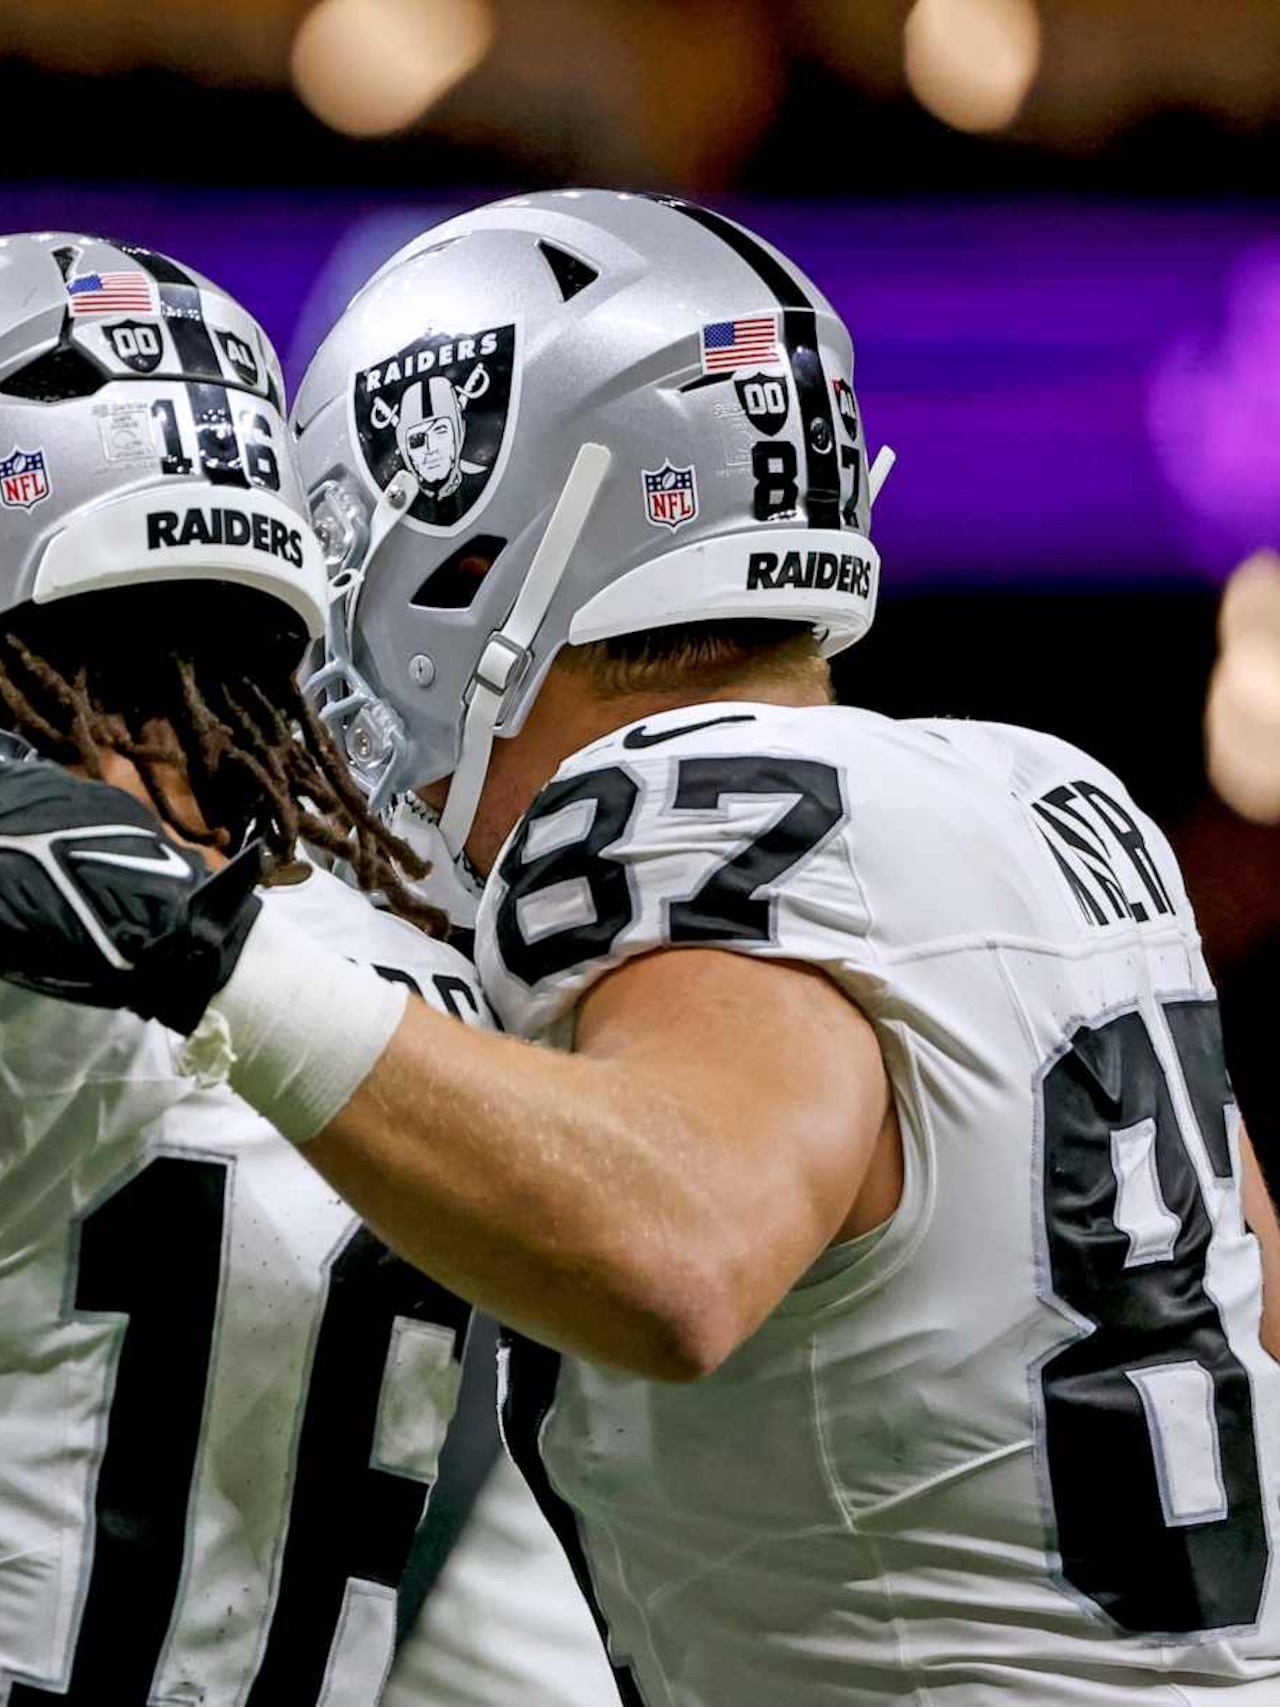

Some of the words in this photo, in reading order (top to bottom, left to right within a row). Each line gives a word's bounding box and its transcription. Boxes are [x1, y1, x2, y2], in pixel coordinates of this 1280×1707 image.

[111, 328, 159, 356] 00
[367, 333, 498, 392] RAIDERS
[3, 473, 47, 502] NFL
[652, 492, 691, 521] NFL
[147, 508, 304, 569] RAIDERS
[747, 551, 871, 600] RAIDERS
[494, 755, 847, 985] 87
[1034, 998, 1270, 1632] 8
